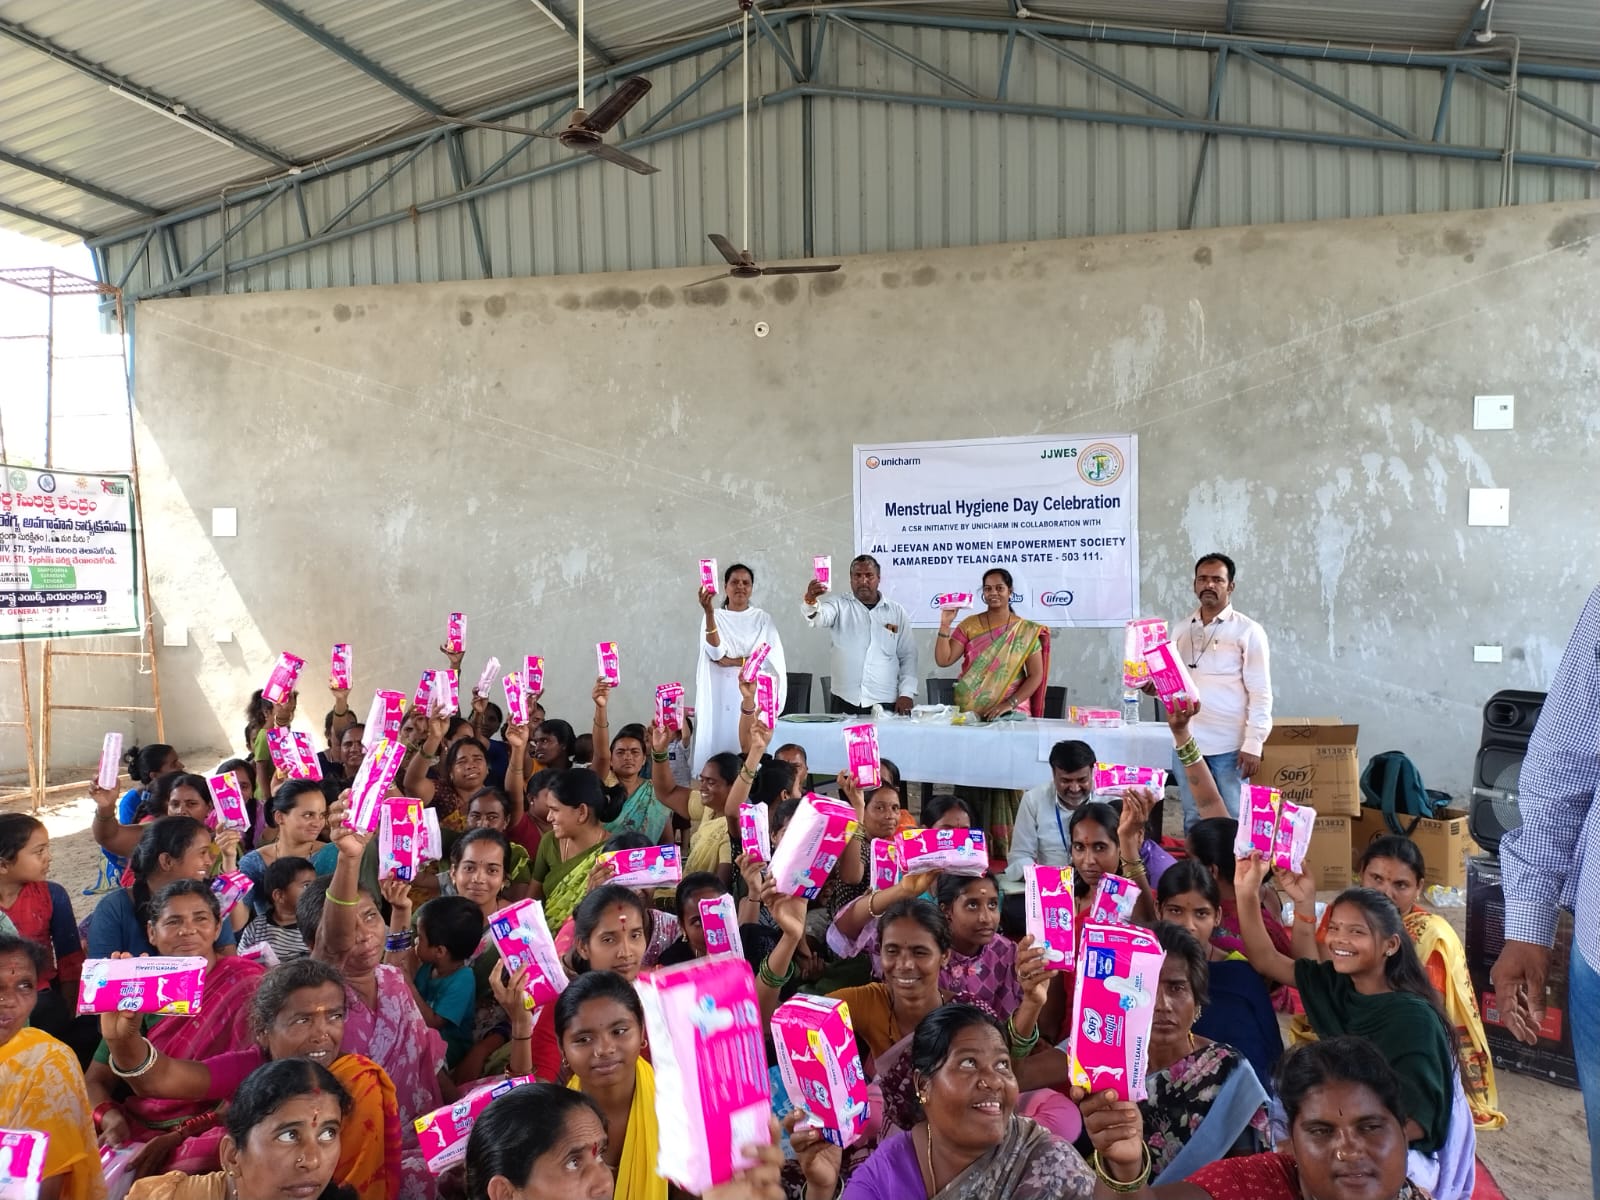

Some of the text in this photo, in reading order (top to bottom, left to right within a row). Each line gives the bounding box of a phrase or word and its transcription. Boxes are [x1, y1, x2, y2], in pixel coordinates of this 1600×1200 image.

[1041, 448, 1077, 459] JJWES
[881, 457, 921, 466] unicharm
[885, 494, 1120, 517] Menstrual Hygiene Day Celebration
[971, 522, 1009, 530] UNICHARM
[1020, 519, 1080, 528] COLLABORATION
[28, 545, 54, 555] Syphilis
[871, 537, 1126, 553] JAL JEEVAN AND WOMEN EMPOWERMENT SOCIETY
[892, 556, 954, 566] KAMAREDDY
[957, 554, 1018, 564] TELANGANA
[1020, 553, 1053, 563] STATE
[1061, 552, 1079, 562] 503
[1082, 552, 1103, 561] 111.
[1046, 594, 1068, 603] lifree
[1280, 770, 1308, 781] SOFY
[1281, 788, 1313, 802] odyfit
[1087, 1015, 1099, 1037] SOFY
[1104, 1014, 1116, 1046] bodyfit
[1132, 1061, 1140, 1089] PREVENTS
